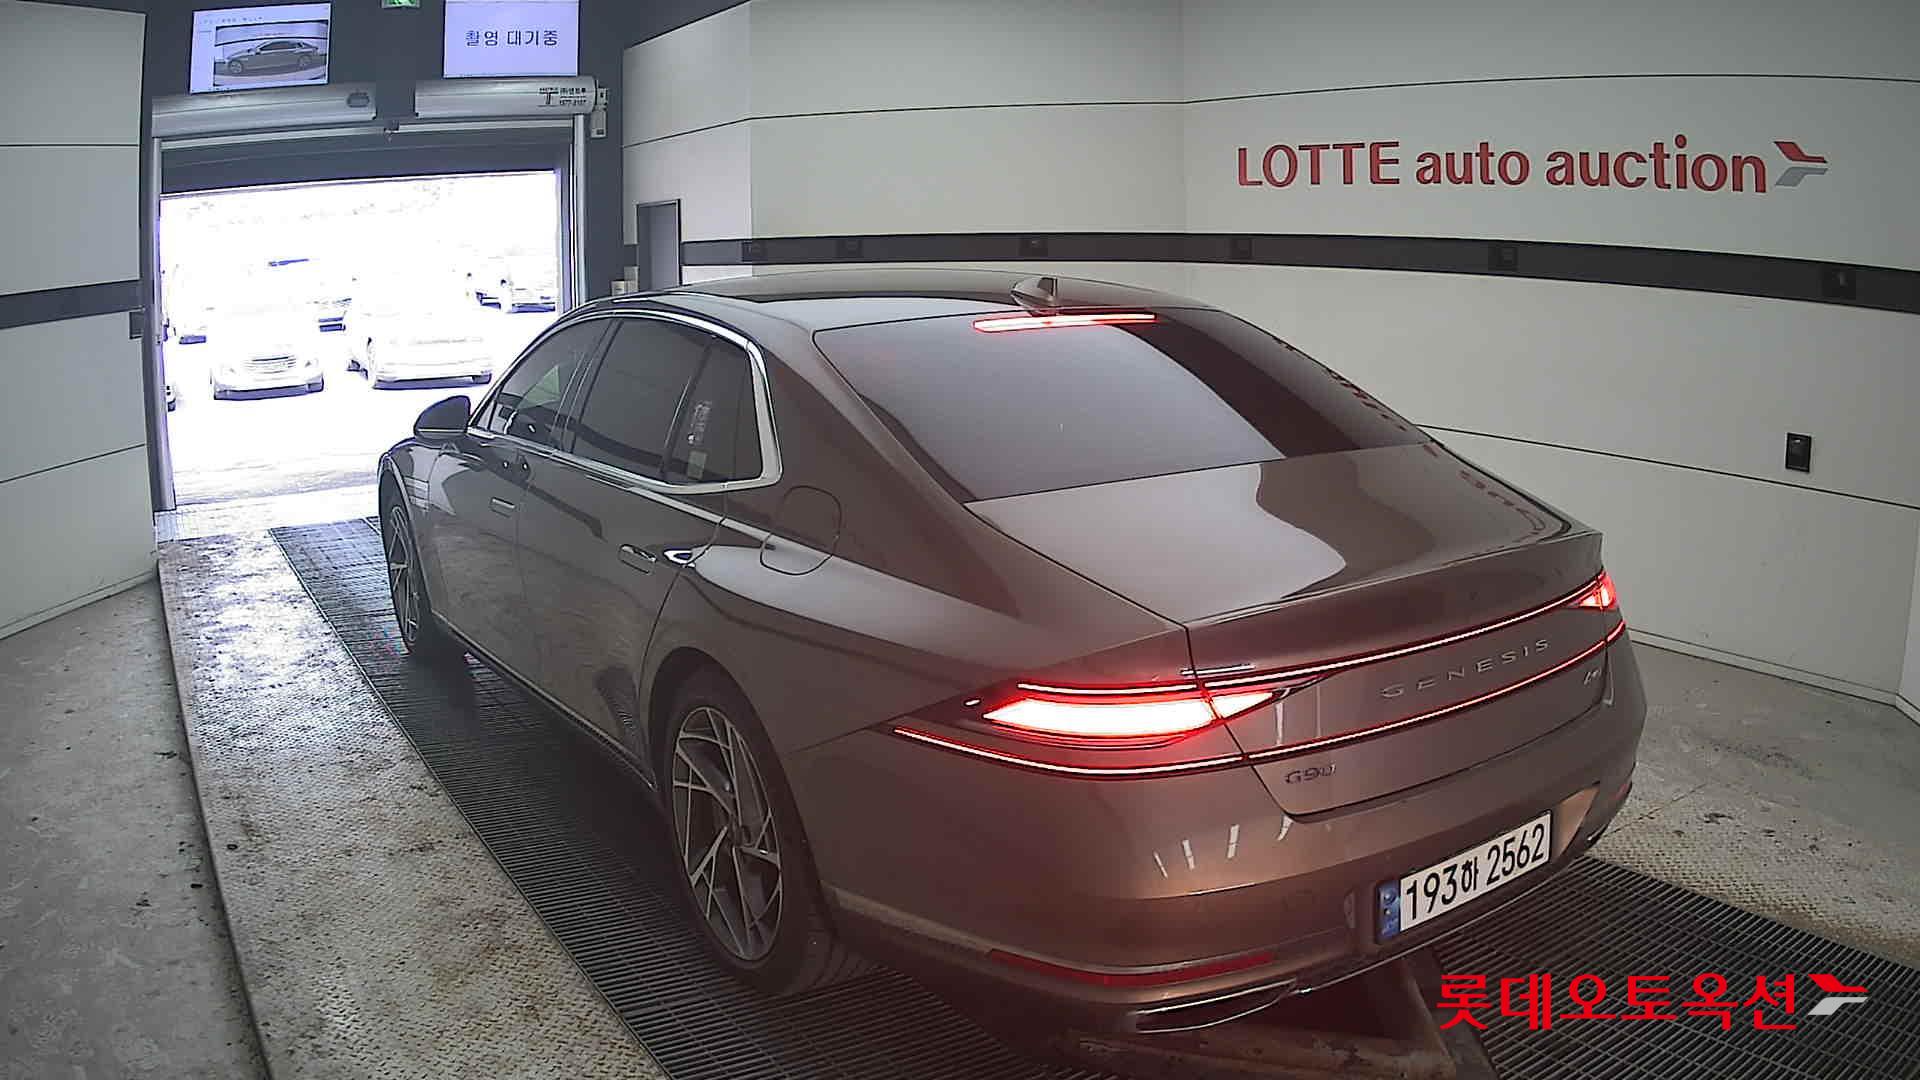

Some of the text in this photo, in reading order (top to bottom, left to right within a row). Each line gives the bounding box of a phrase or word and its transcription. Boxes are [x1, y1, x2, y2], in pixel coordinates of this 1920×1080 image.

[464, 30, 558, 47] 촬영 대기중
[1237, 133, 1767, 193] LOTTE auto auction
[1379, 638, 1550, 699] GENESIS
[1285, 764, 1336, 783] G90
[1406, 823, 1545, 920] 193하 2562
